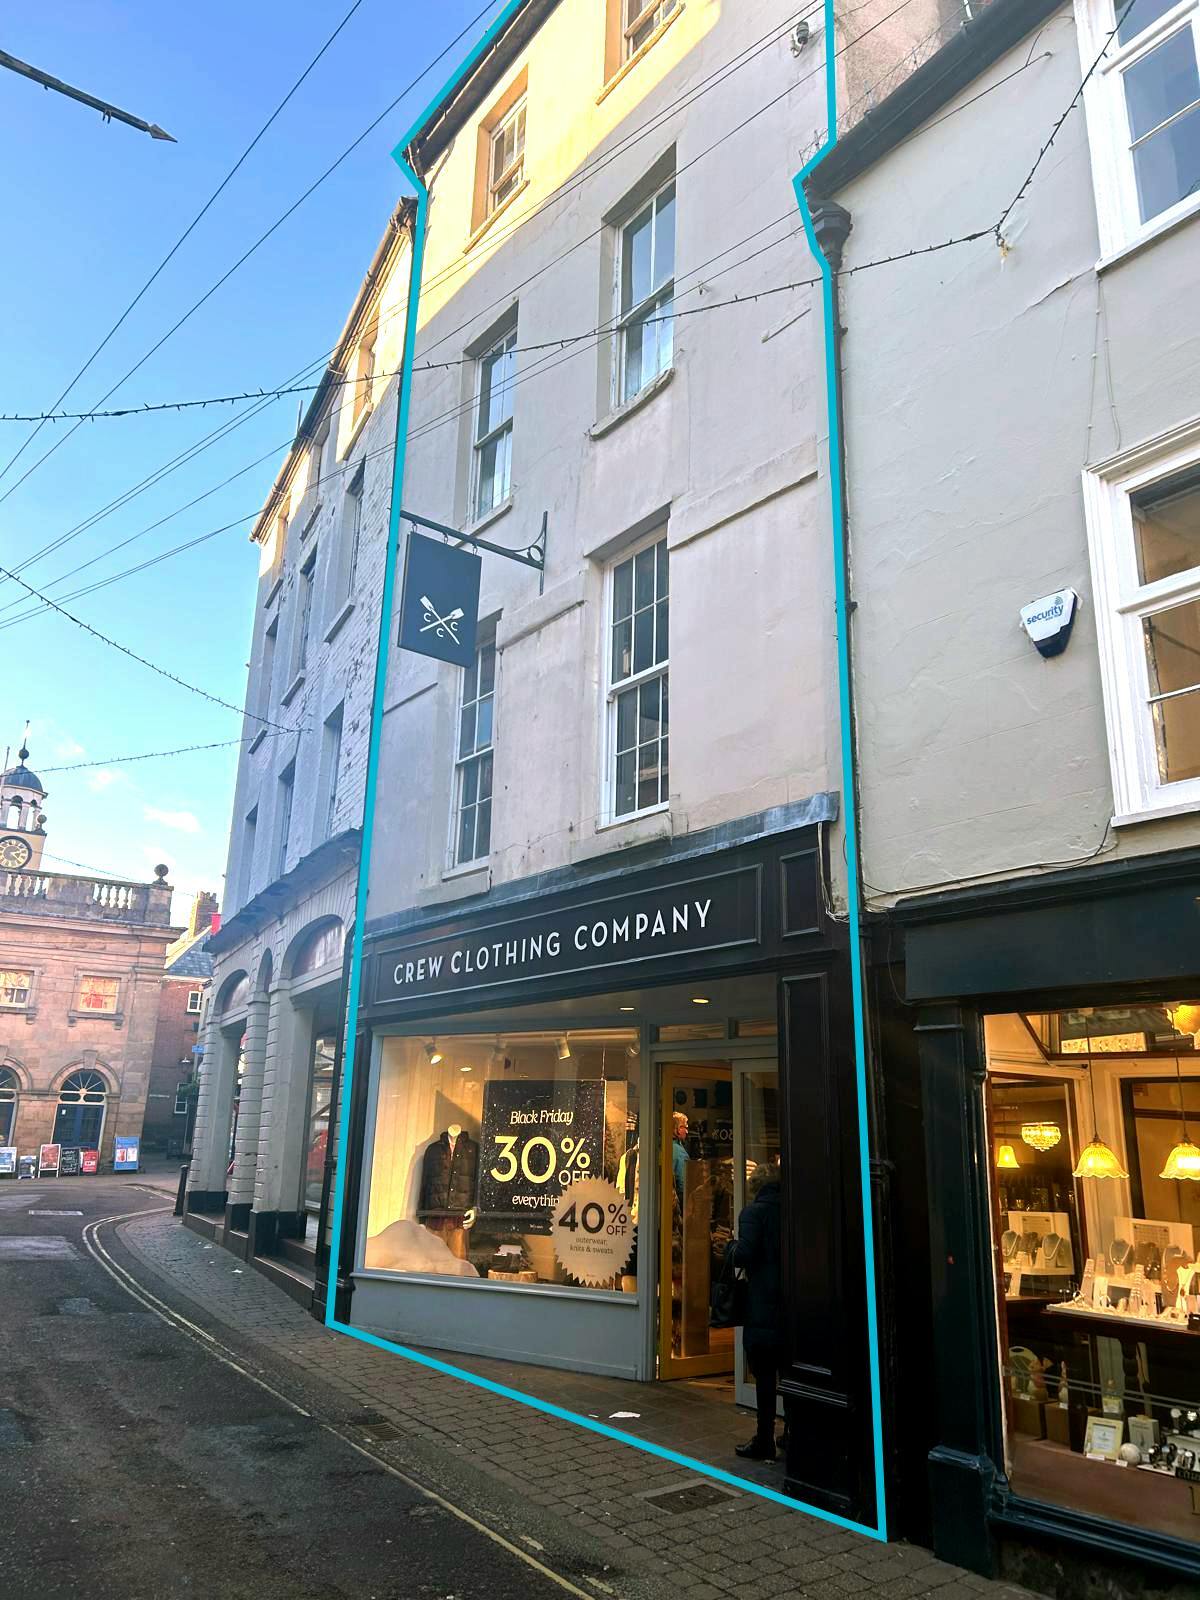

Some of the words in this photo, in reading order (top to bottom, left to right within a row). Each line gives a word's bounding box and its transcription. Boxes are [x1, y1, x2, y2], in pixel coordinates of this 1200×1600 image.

[1026, 604, 1064, 625] security
[393, 955, 444, 985] CREW
[450, 931, 562, 975] CLOTHING
[573, 899, 712, 951] COMPANY
[510, 1110, 538, 1125] Black
[540, 1109, 574, 1126] Friday
[490, 1136, 591, 1184] 30%
[512, 1194, 560, 1209] everythin
[558, 1201, 627, 1234] 40%
[606, 1225, 627, 1236] OFF
